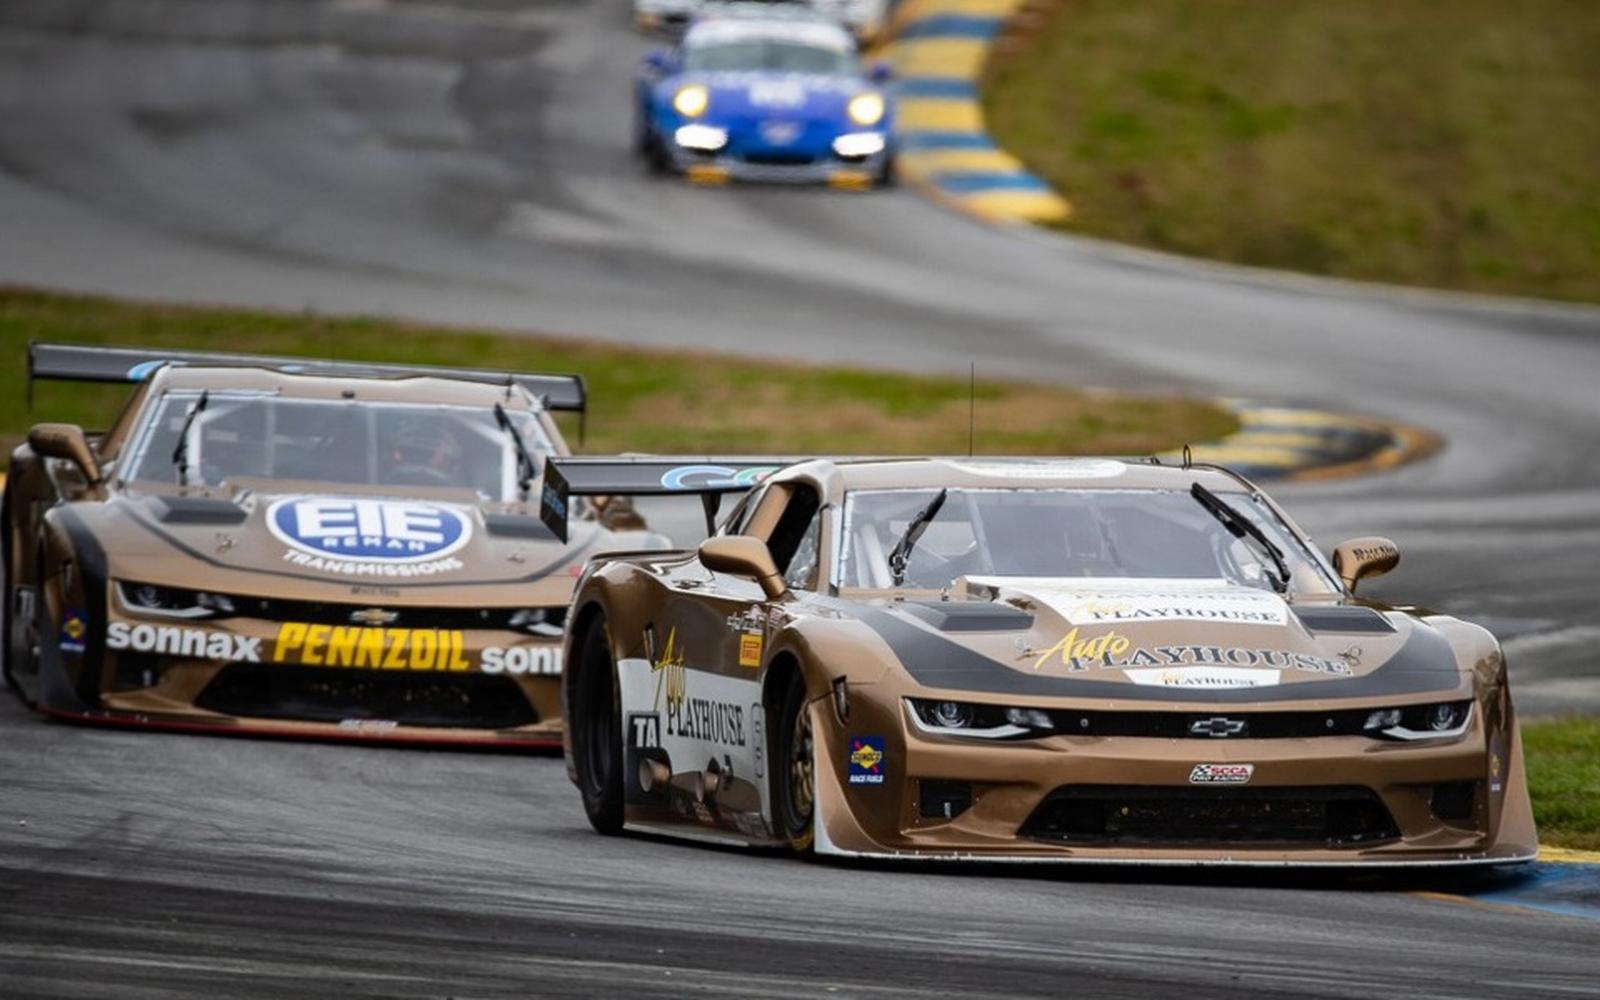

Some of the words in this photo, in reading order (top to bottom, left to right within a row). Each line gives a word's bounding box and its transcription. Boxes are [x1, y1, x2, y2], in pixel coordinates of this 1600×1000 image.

[283, 549, 463, 577] TRANSMISSIONS
[1091, 607, 1282, 623] PLAYHOUSE
[106, 621, 262, 663] sonnax
[272, 621, 471, 672] PENNZOIL
[1034, 626, 1131, 670] Auto
[1068, 643, 1354, 677] PLAYHOUSE
[633, 717, 659, 748] TA
[666, 697, 746, 747] PLAYHOUSE
[1210, 766, 1249, 776] SCCA
